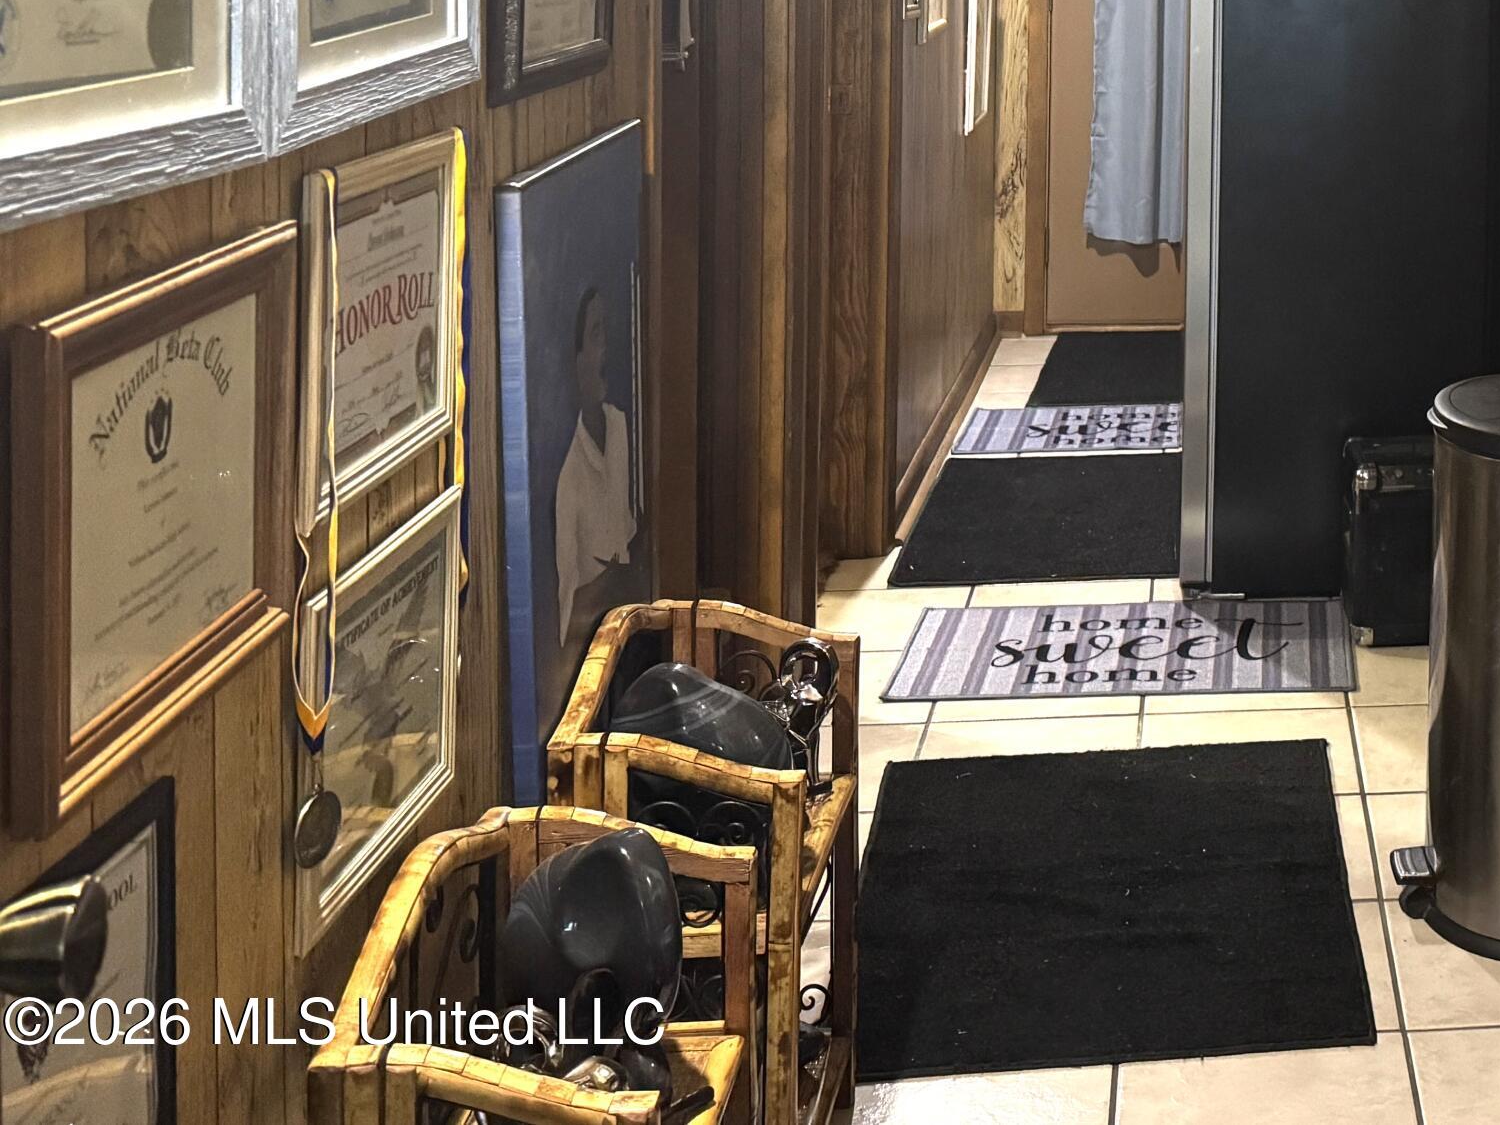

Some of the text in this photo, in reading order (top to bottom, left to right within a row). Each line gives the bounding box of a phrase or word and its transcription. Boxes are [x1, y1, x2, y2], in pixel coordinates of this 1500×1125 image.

[330, 272, 435, 358] HONOR ROLL
[89, 328, 232, 454] National Beta Club
[1026, 420, 1177, 438] swee
[1039, 614, 1203, 633] home
[991, 618, 1303, 667] sweet
[1021, 664, 1198, 686] home
[108, 874, 137, 910] OOL
